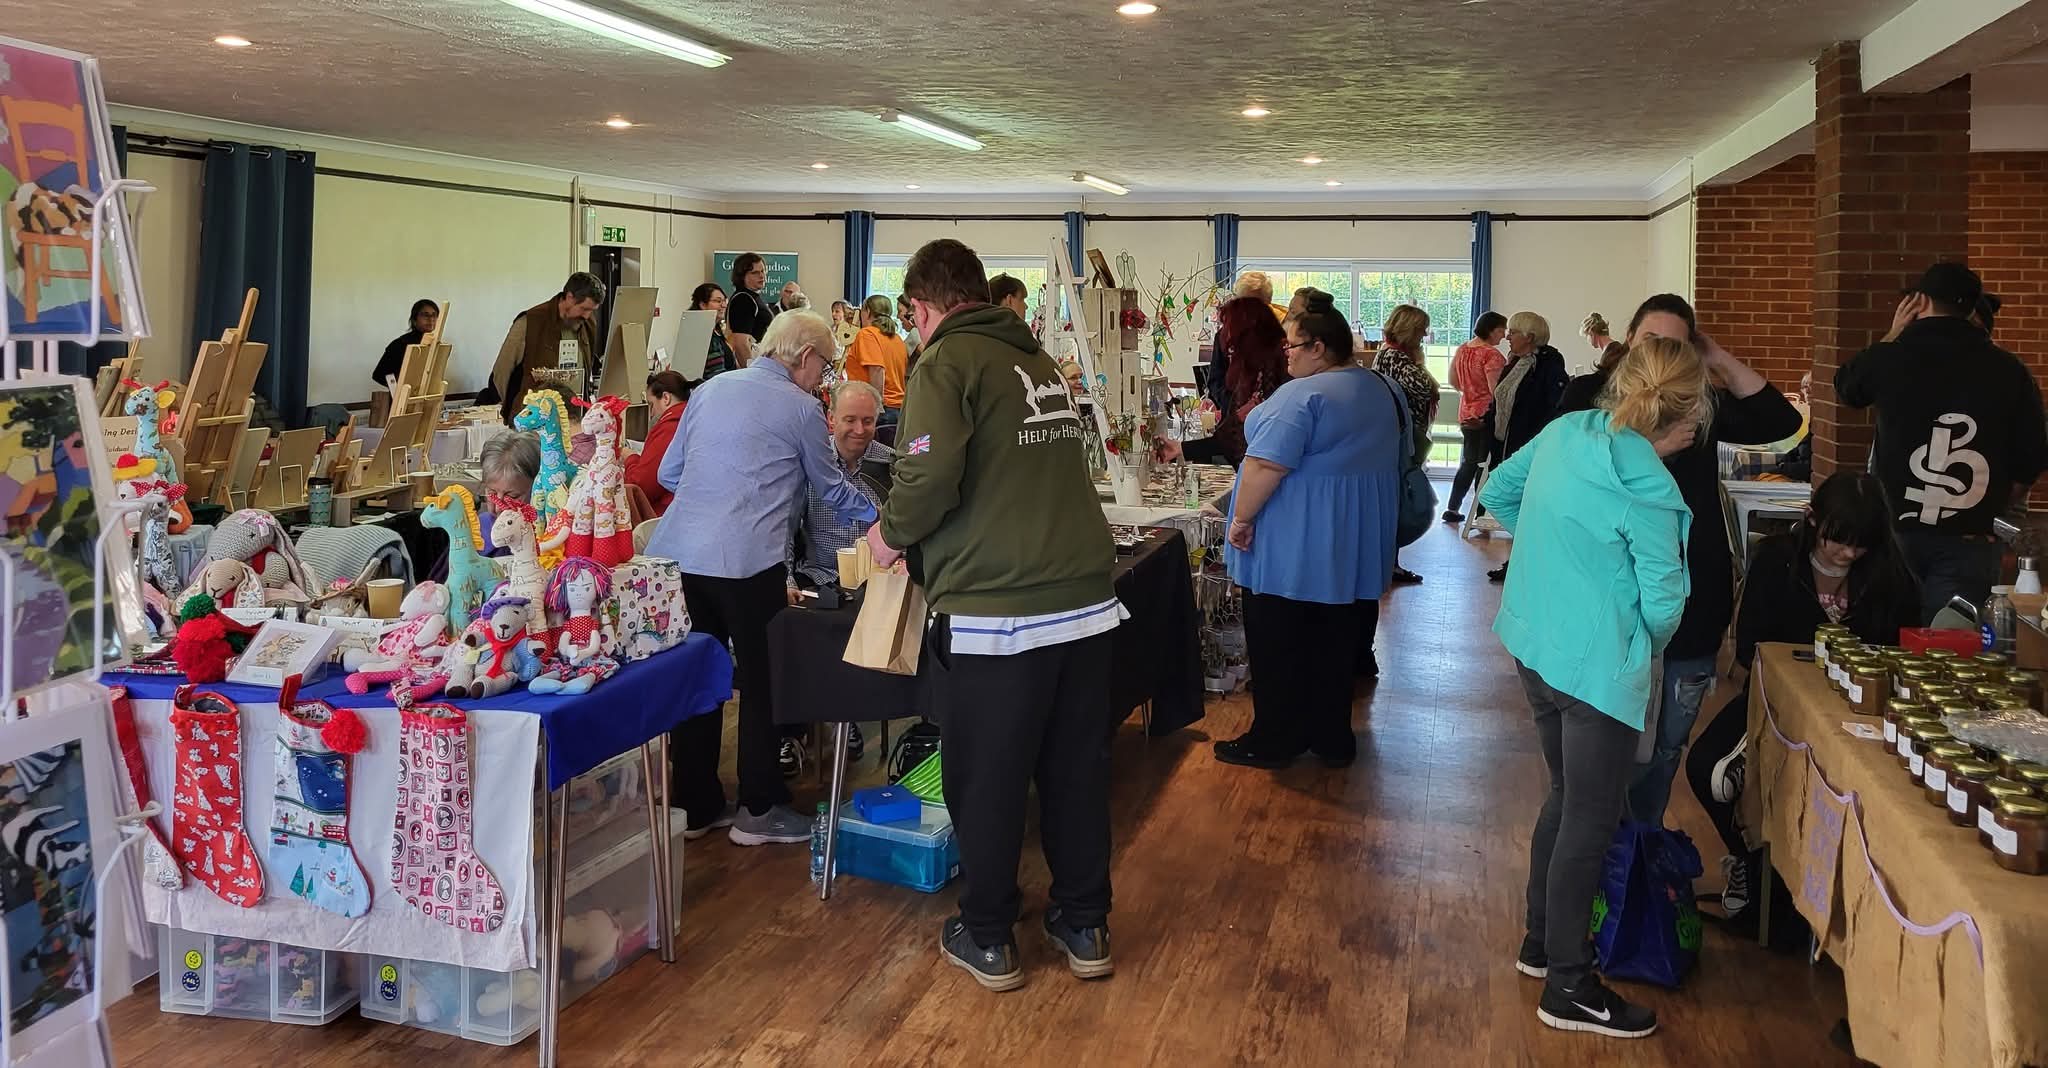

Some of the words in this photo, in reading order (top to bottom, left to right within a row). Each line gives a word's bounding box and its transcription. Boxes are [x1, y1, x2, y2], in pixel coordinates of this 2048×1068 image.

[766, 261, 791, 272] udios
[104, 428, 118, 438] ing
[1017, 429, 1048, 446] HELP
[1048, 427, 1062, 444] for
